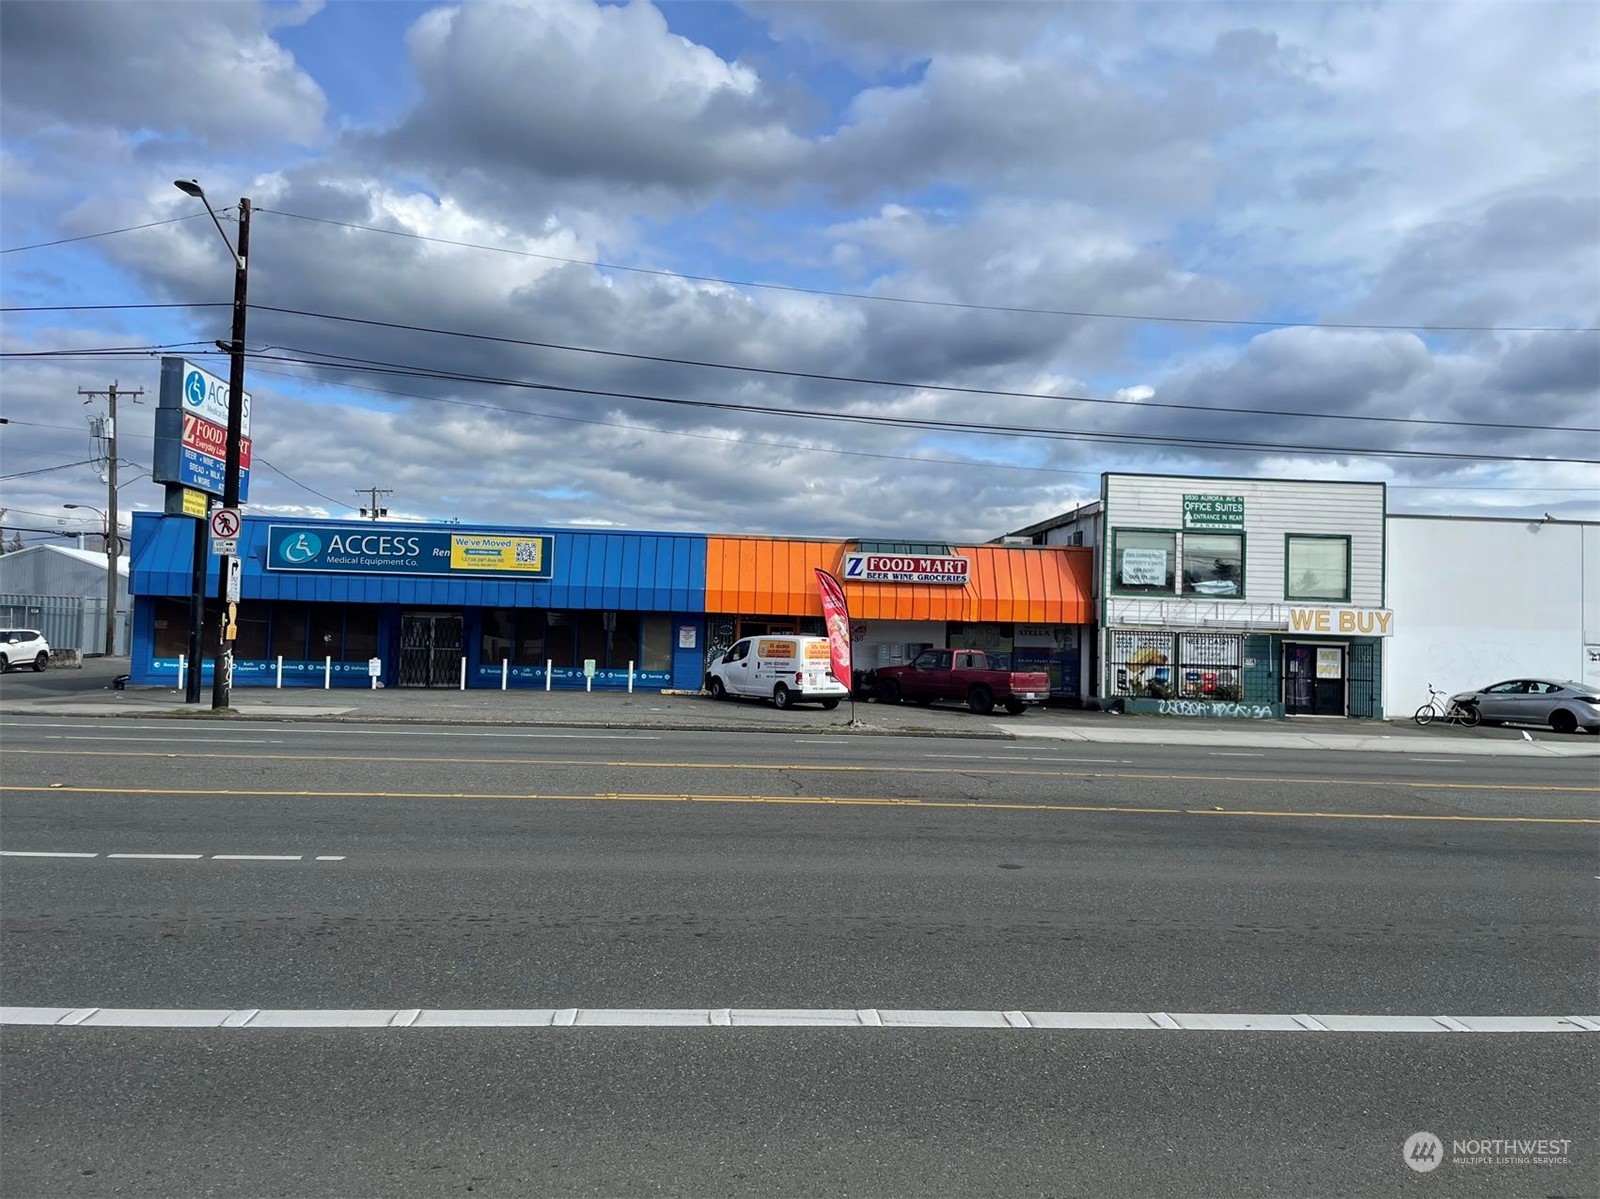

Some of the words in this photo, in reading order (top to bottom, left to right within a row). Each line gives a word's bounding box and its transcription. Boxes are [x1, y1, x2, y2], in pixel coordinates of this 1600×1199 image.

[208, 381, 249, 418] ACCS
[183, 413, 196, 444] Z
[196, 418, 223, 445] FOOD
[195, 438, 216, 454] Everyday
[184, 449, 197, 460] BEER
[189, 462, 204, 474] BREAD
[210, 469, 220, 480] MILK
[1184, 501, 1212, 511] OFFICE
[1215, 502, 1243, 512] SUITES
[327, 534, 420, 556] ACCESS
[455, 538, 481, 547] We've
[482, 539, 512, 548] Moved
[432, 548, 451, 557] Ren
[326, 555, 358, 564] Medical
[360, 557, 404, 567] Equipment
[405, 558, 419, 567] Co.
[847, 557, 864, 576] Z
[869, 558, 915, 572] FOOD
[919, 559, 965, 573] MART
[866, 572, 889, 580] BEER
[892, 573, 914, 581] WINE
[917, 574, 967, 582] GROCERIES
[1290, 609, 1331, 631] WE
[1339, 610, 1392, 633] BUY
[1319, 650, 1338, 661] WE
